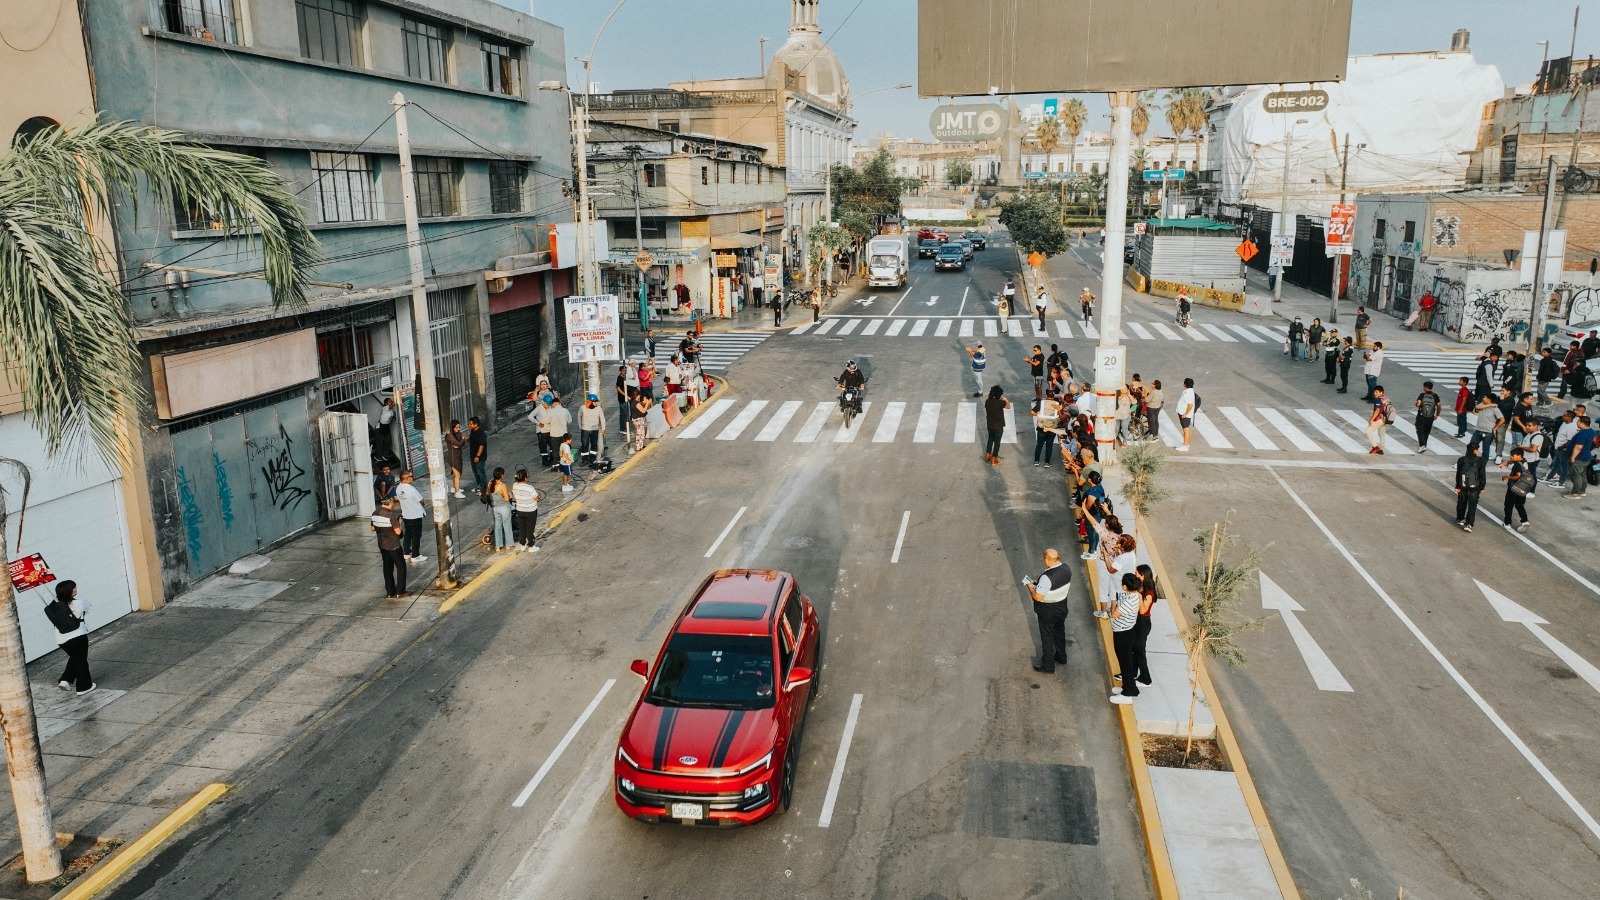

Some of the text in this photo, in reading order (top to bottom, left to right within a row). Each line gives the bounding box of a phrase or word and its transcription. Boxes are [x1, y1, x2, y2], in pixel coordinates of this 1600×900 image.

[1268, 96, 1324, 108] BRE-002
[937, 112, 977, 129] JMT
[936, 129, 976, 137] outdoors
[1329, 223, 1345, 235] 23
[591, 345, 597, 357] 1
[602, 344, 613, 355] 10
[1104, 356, 1116, 365] 20
